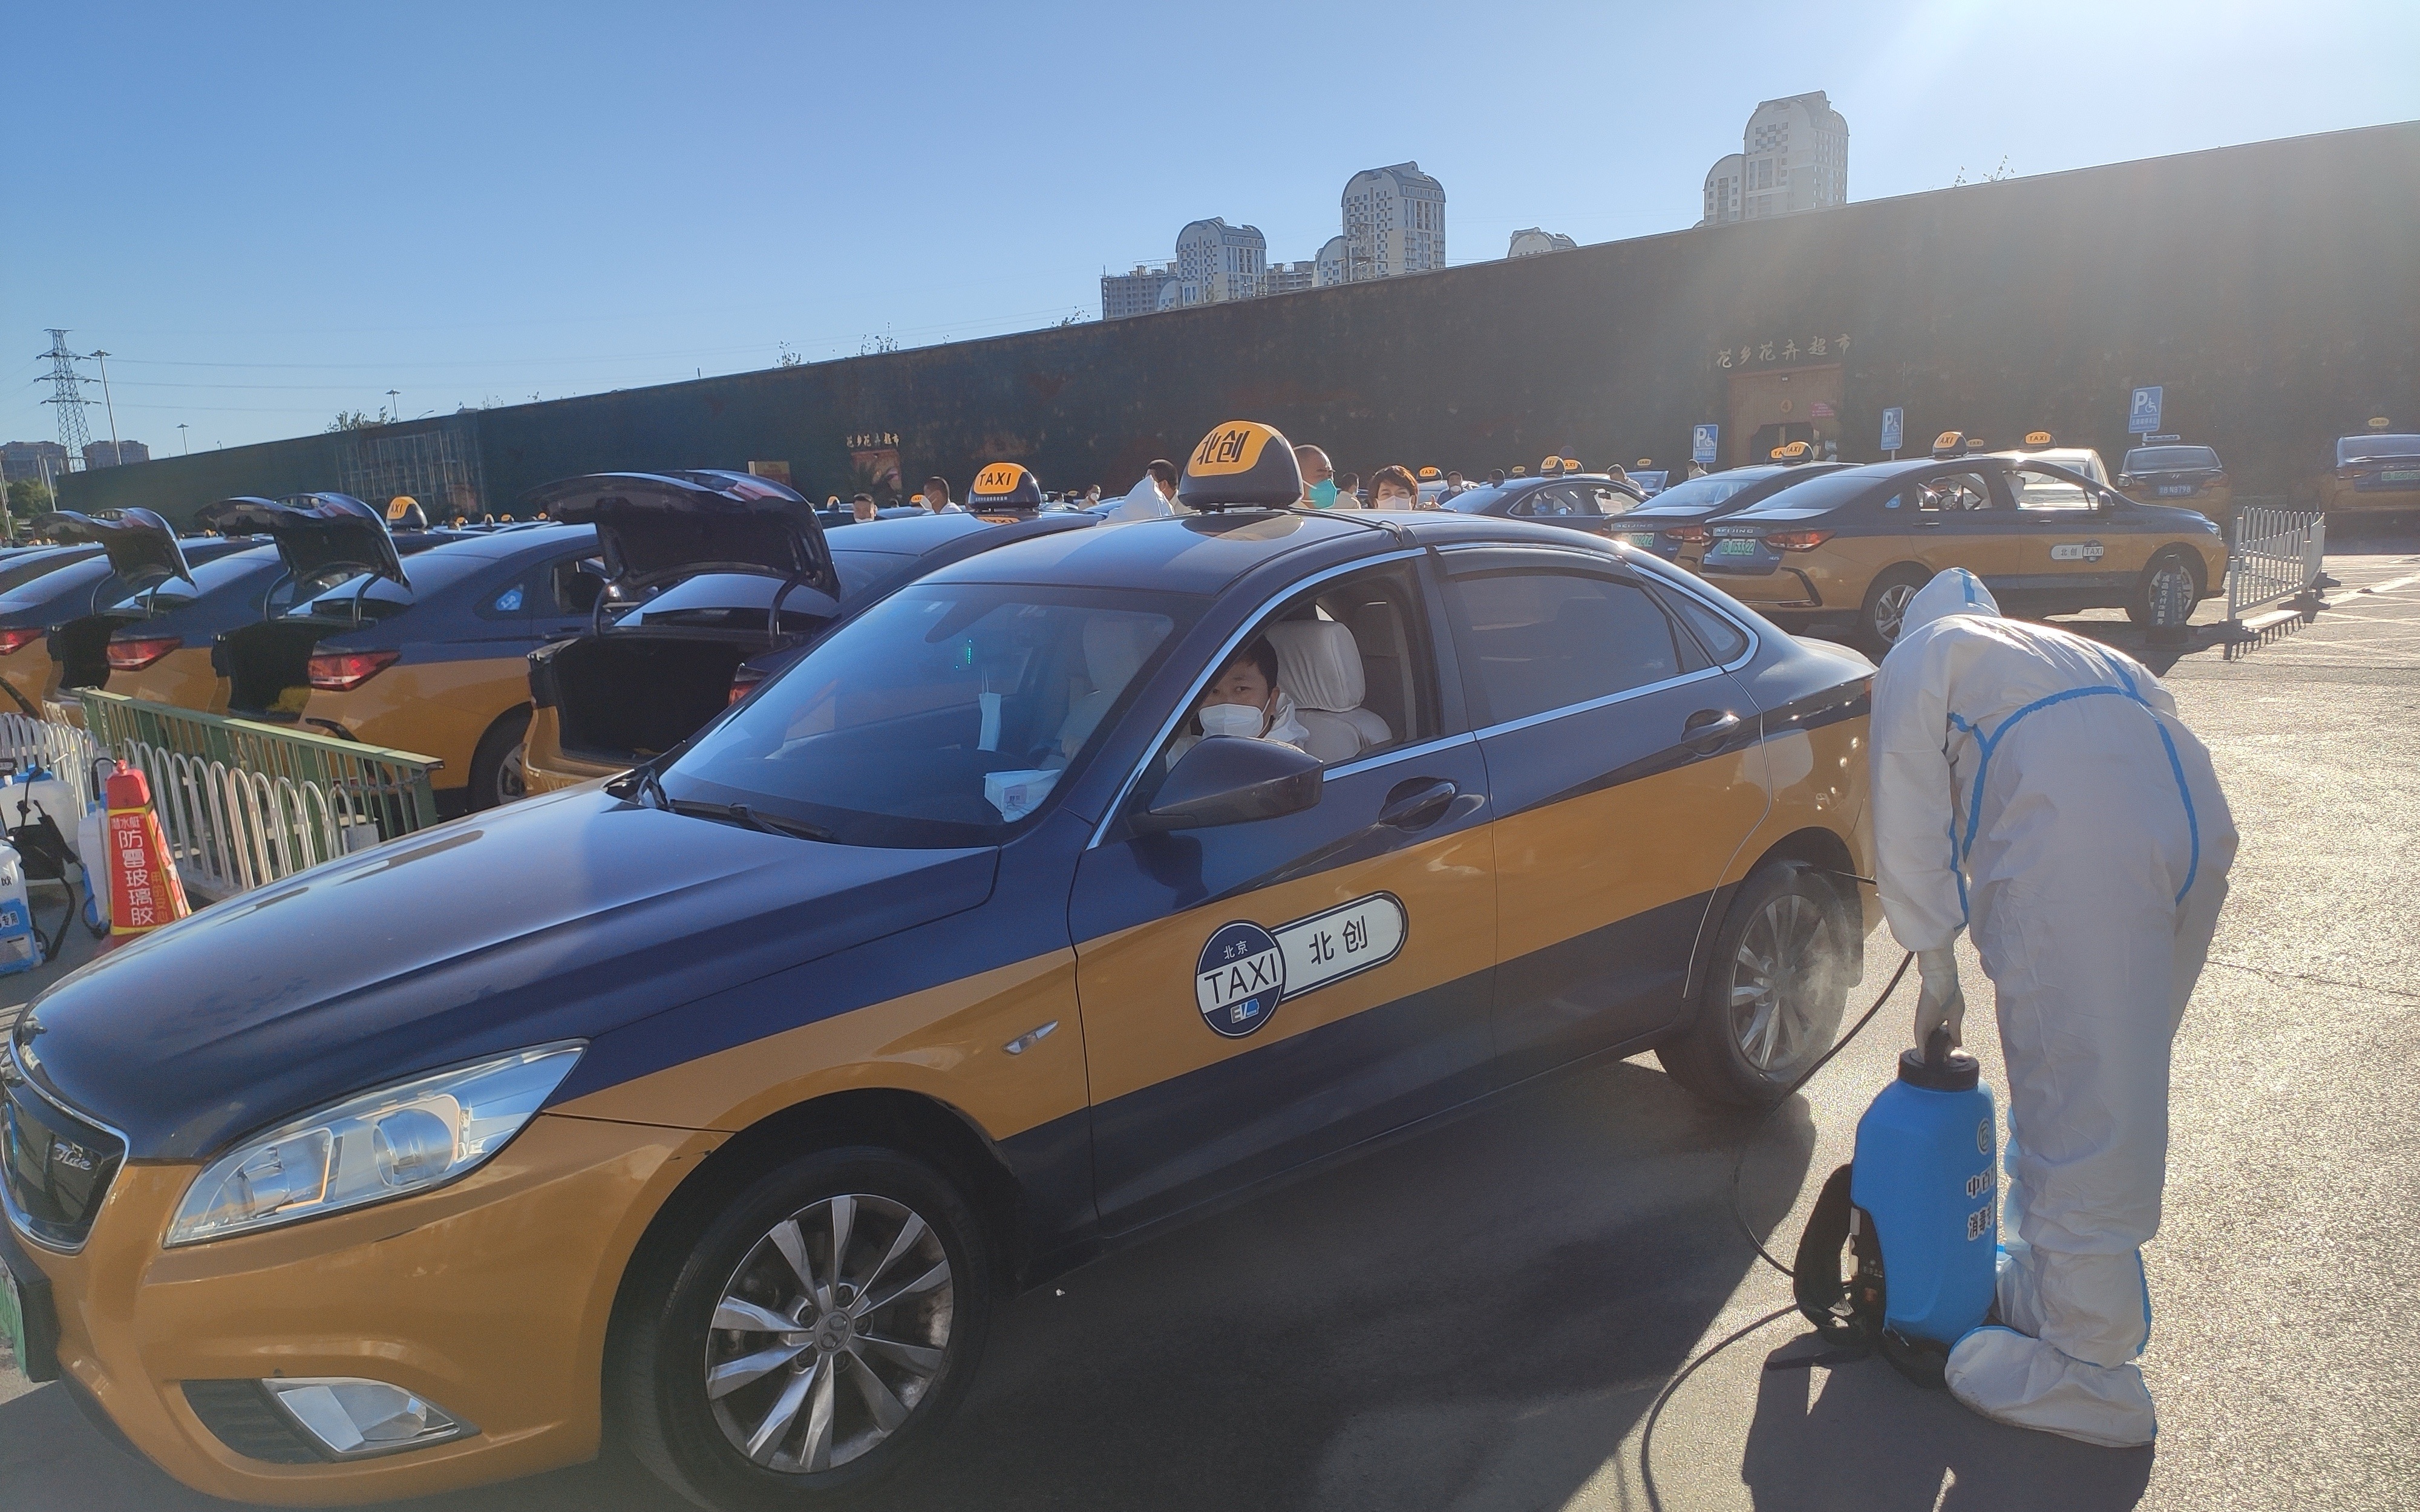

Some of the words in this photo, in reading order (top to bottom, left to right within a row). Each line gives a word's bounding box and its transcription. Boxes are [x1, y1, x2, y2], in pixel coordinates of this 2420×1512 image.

[1716, 333, 1851, 368] 花乡花卉超市
[2134, 391, 2148, 414] P
[1884, 411, 1894, 433] P
[1196, 430, 1251, 465] 北创
[1696, 427, 1707, 448] P
[979, 472, 1012, 486] TAXI
[390, 503, 404, 514] AXI
[2061, 548, 2077, 556] 北创
[1223, 940, 1249, 960] 北京
[1308, 915, 1369, 966] 北创
[1203, 952, 1277, 1004] TAXI
[1968, 1167, 1994, 1196] 中百
